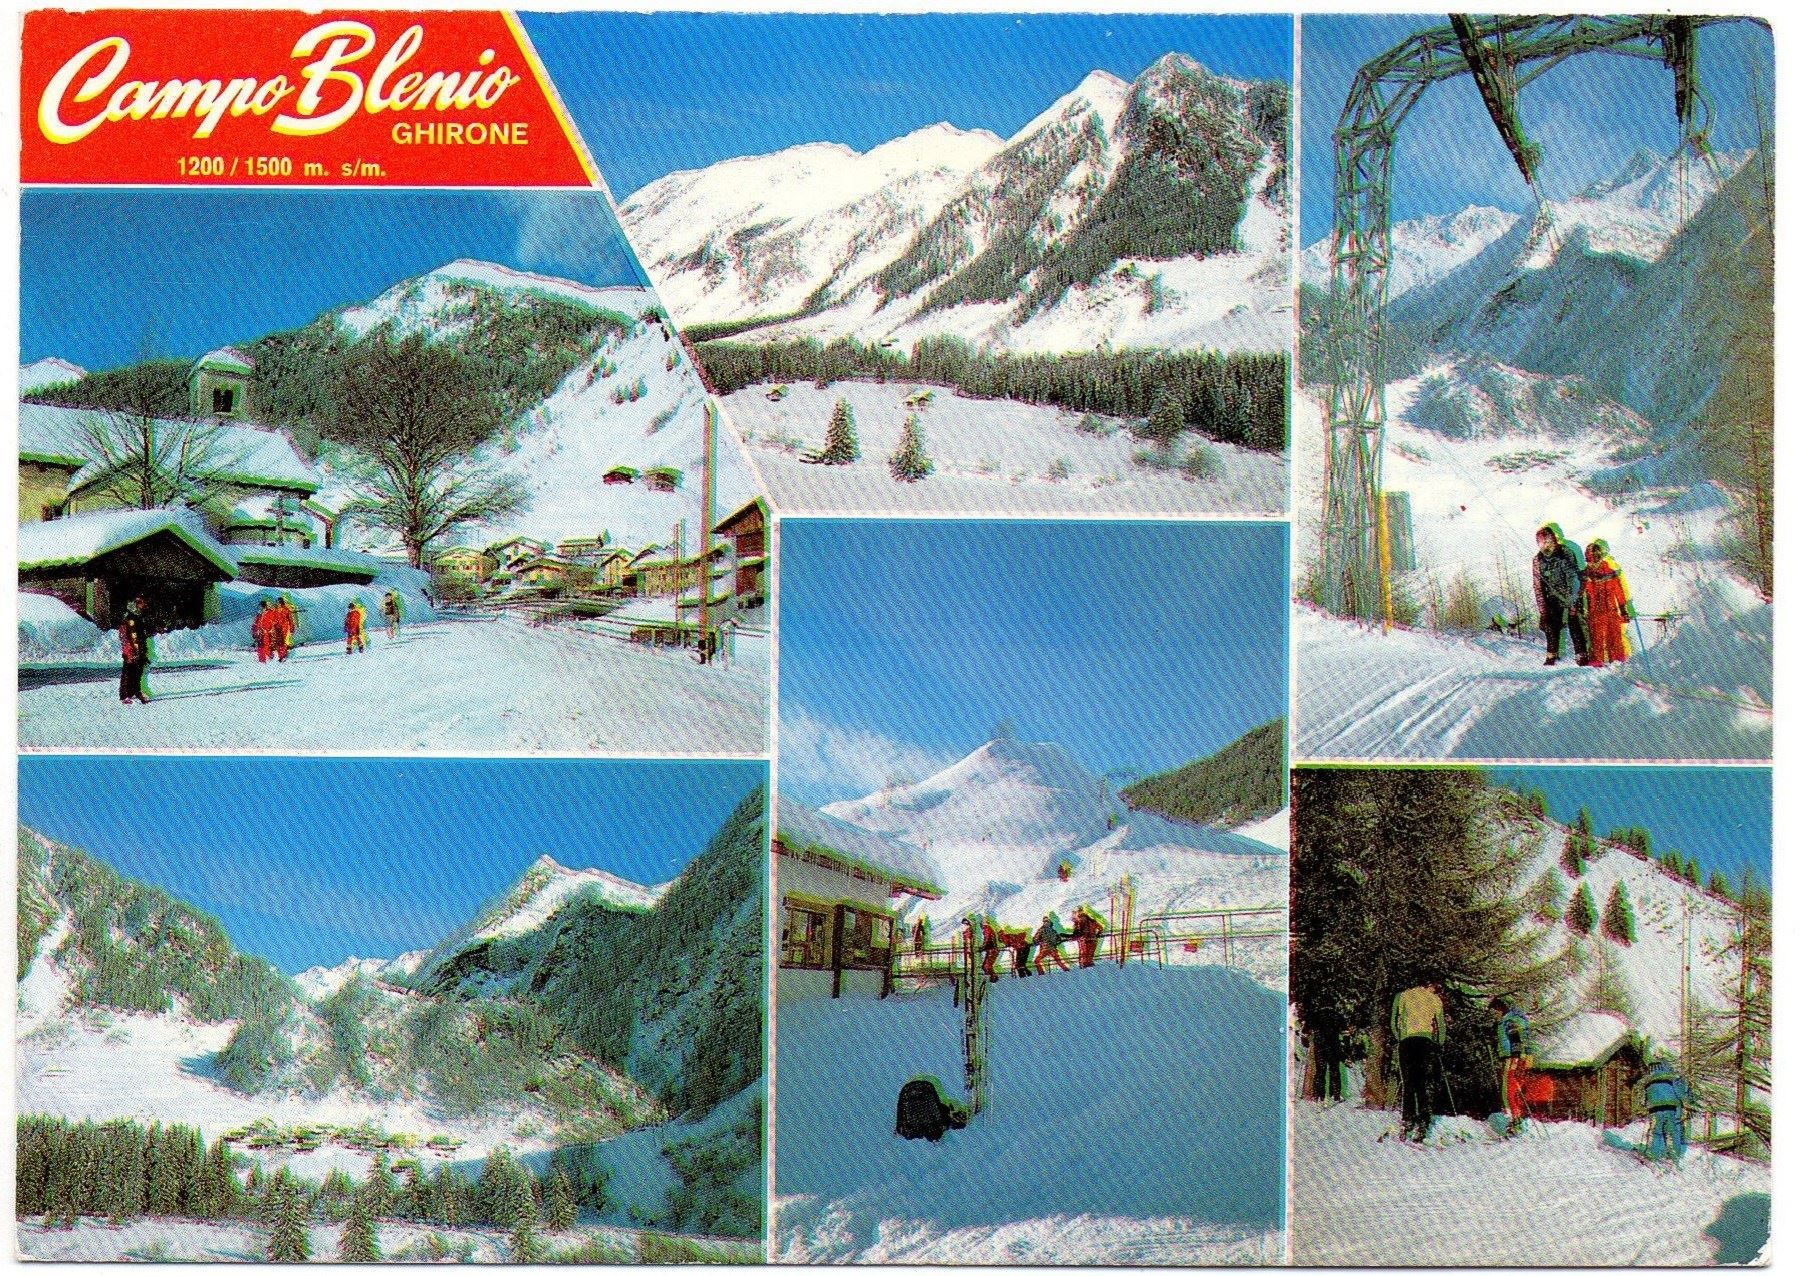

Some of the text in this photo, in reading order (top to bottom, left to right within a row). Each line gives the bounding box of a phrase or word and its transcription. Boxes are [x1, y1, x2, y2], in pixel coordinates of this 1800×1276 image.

[37, 20, 521, 145] Campo Blenio
[391, 122, 529, 145] GHIRONE
[177, 156, 225, 177] 1200
[245, 156, 293, 177] 1500
[303, 162, 329, 177] m.
[341, 157, 387, 177] s/m.
